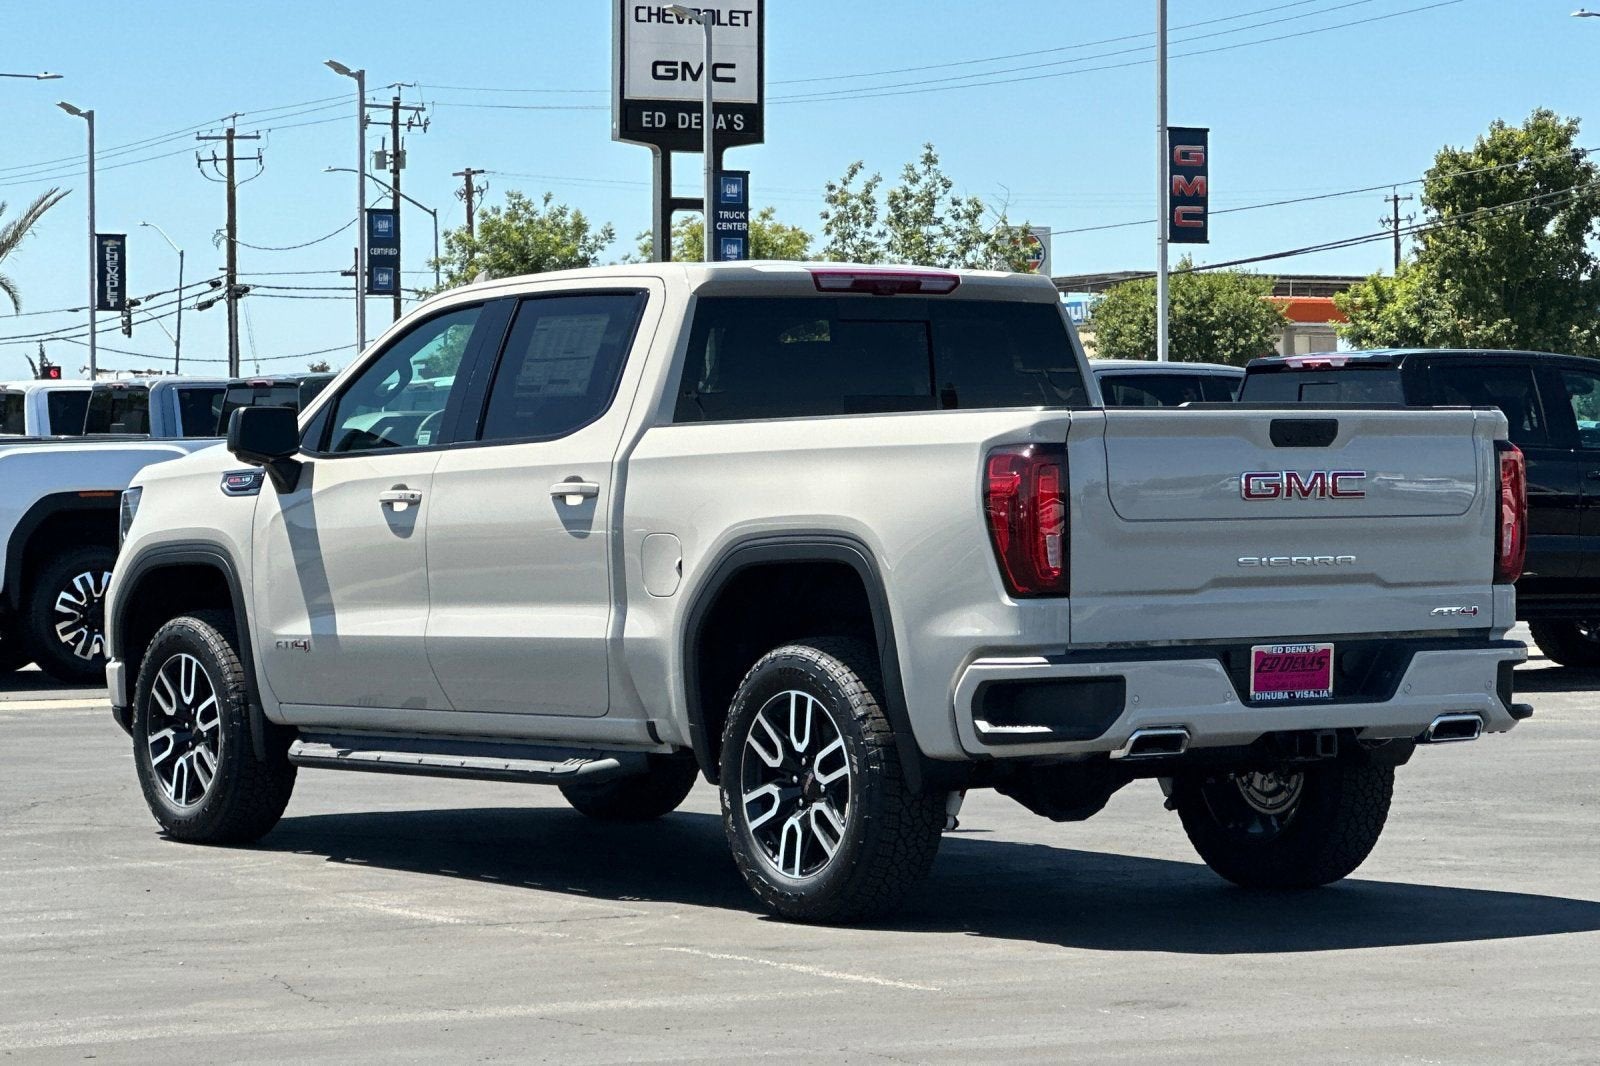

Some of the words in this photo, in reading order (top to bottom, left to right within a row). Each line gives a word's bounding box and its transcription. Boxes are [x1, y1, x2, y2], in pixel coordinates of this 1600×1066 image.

[652, 60, 736, 83] GMC
[642, 111, 667, 128] ED
[678, 112, 745, 131] DEA'S
[726, 183, 738, 194] GM
[1173, 144, 1207, 228] GMC
[718, 210, 745, 219] TRUCK
[377, 220, 389, 229] GM
[716, 222, 748, 230] CENTER
[369, 247, 398, 256] CERTIFIED
[726, 243, 738, 255] GM
[106, 246, 119, 307] CHEVROLET
[378, 273, 389, 282] GM
[1241, 470, 1366, 500] GMC
[1237, 555, 1356, 567] SIERRA
[1430, 605, 1479, 618] AT4
[1272, 646, 1284, 654] ED
[1285, 645, 1315, 653] DENA'S
[1255, 692, 1289, 700] DINUBA
